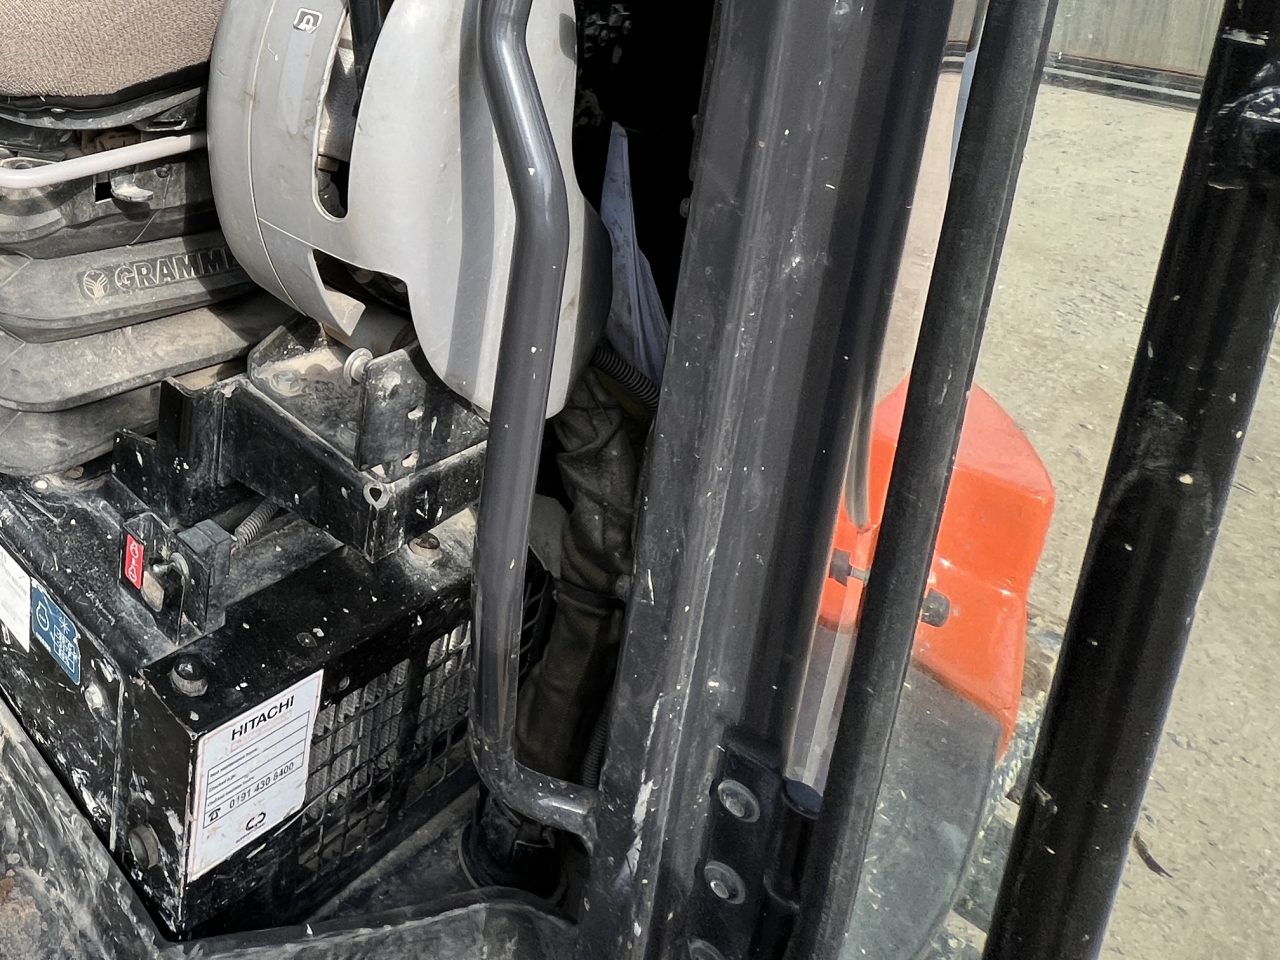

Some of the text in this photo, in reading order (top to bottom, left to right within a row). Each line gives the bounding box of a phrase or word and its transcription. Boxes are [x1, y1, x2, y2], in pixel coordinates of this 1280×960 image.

[114, 248, 231, 291] GRAMM
[231, 695, 295, 741] HITACHI
[229, 789, 252, 809] 0191
[254, 777, 271, 793] 430
